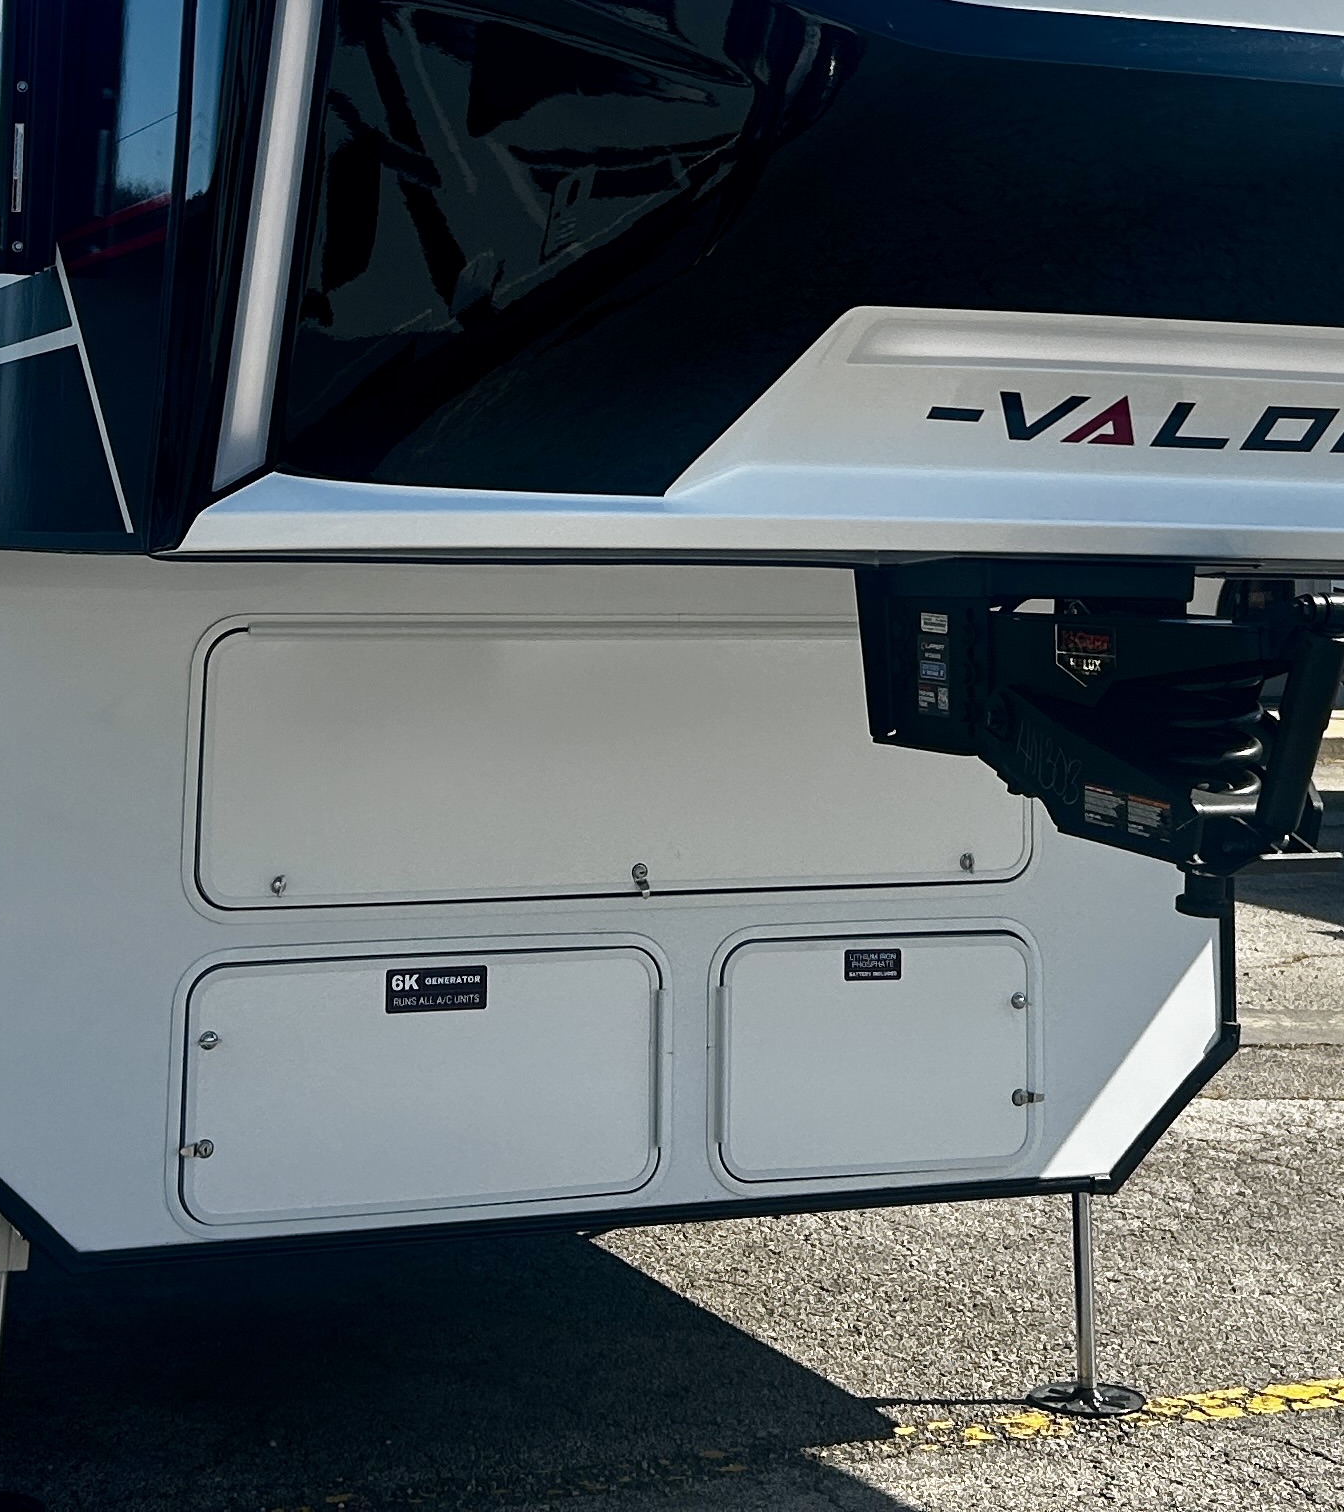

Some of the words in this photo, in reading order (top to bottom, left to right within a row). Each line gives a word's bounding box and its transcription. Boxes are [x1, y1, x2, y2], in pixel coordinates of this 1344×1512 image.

[851, 960, 894, 968] PHOSPHATE
[391, 973, 420, 991] 6K
[424, 975, 481, 985] GENERATOR
[393, 996, 417, 1007] RUNS
[418, 995, 435, 1006] ALL
[436, 994, 453, 1005] A/C
[454, 993, 481, 1004] UNITS
